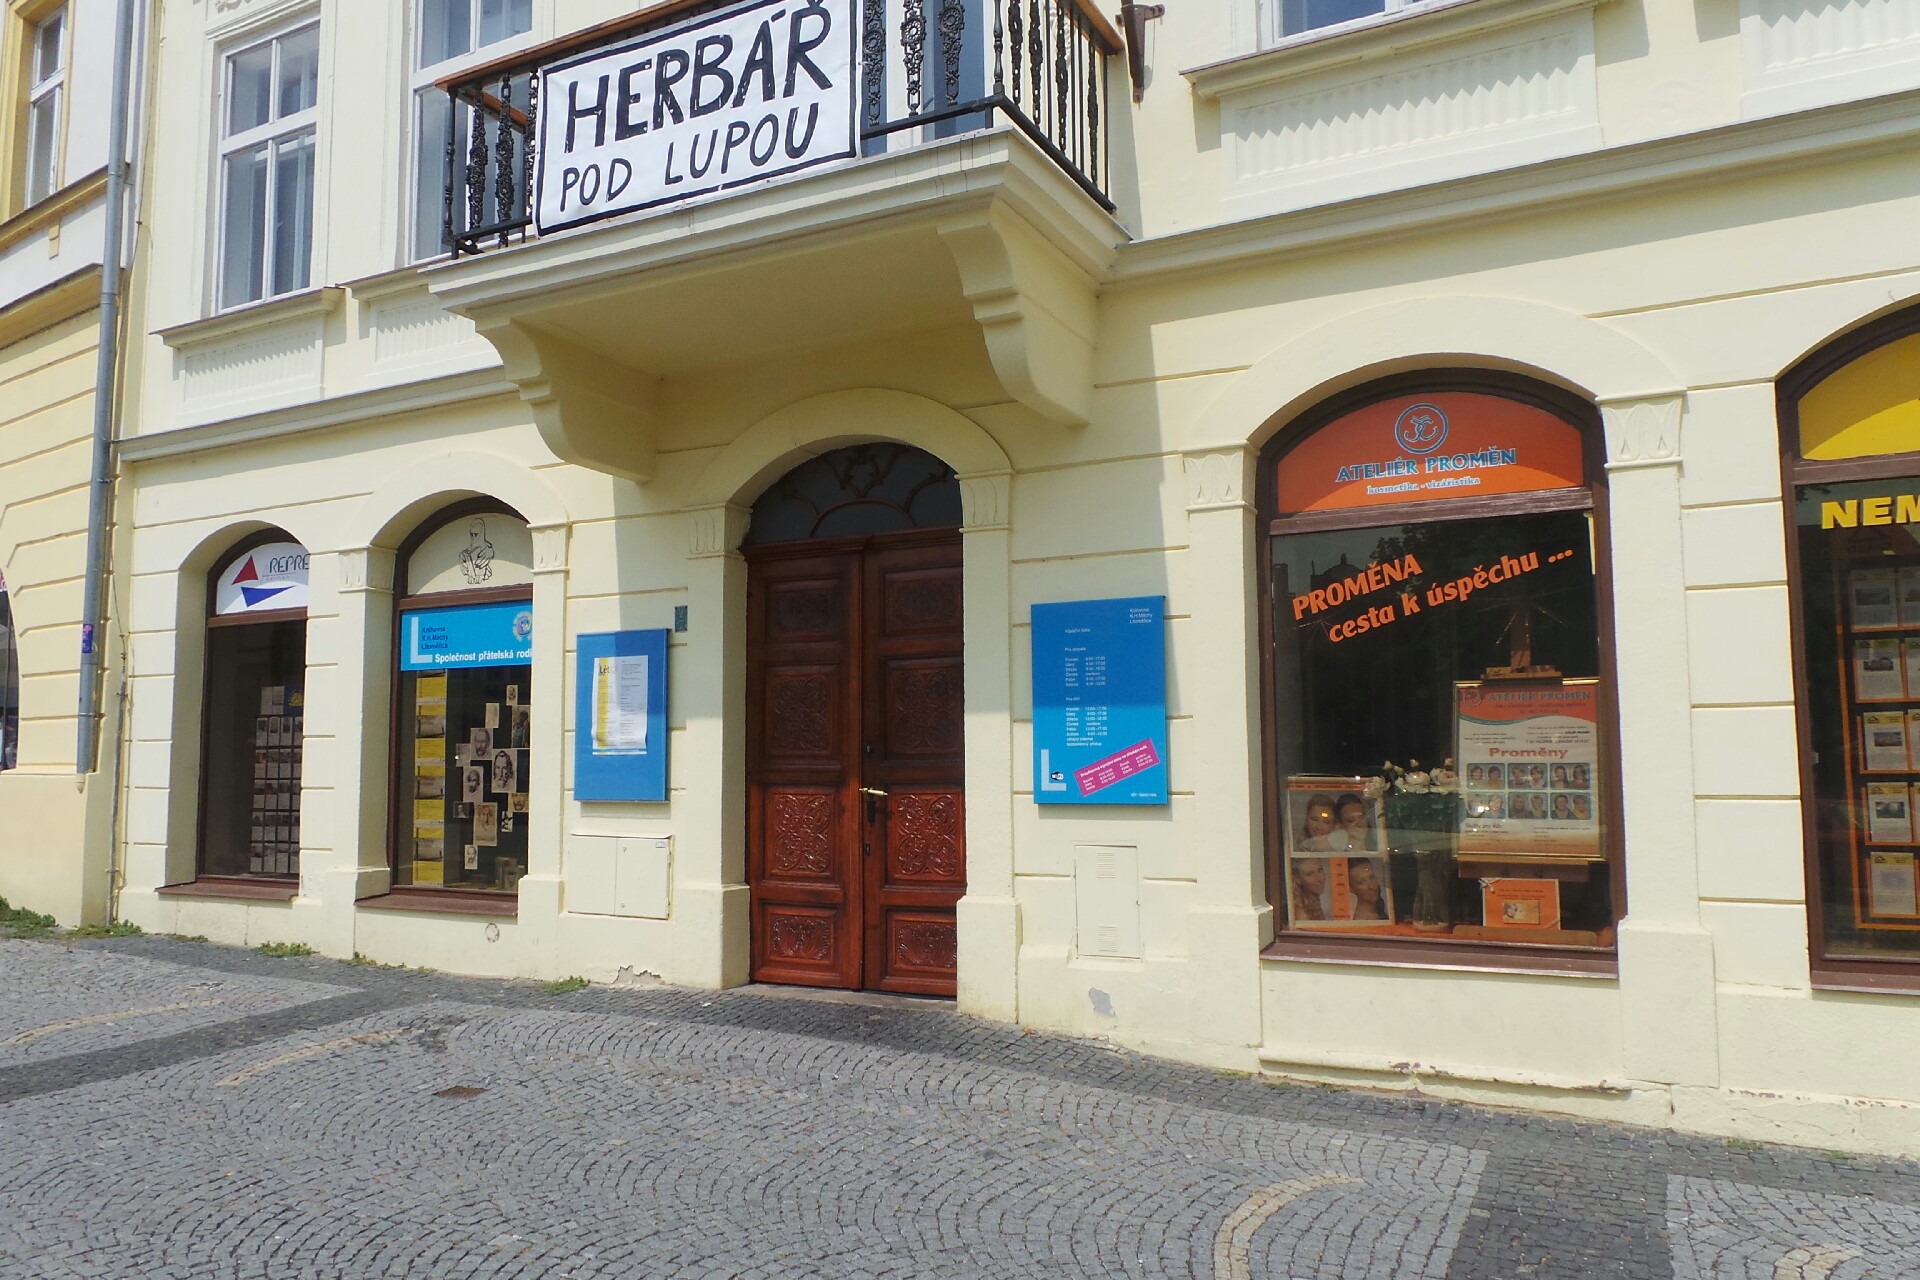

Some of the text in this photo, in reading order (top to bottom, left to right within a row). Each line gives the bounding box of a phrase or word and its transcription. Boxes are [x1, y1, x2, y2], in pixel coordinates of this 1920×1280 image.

[564, 0, 834, 154] HERBÁŘ
[559, 102, 819, 212] POD LUPOU
[1335, 445, 1517, 483] ATELIÉR PROMĚN
[1367, 481, 1419, 495] kosmetika
[1292, 553, 1423, 621] PROMĚNA
[1329, 604, 1395, 643] cesta
[1400, 592, 1421, 616] k
[1426, 552, 1539, 607] úspěchu
[435, 652, 476, 664] Společnost
[478, 649, 514, 662] přátelská
[1489, 747, 1568, 759] Proměny
